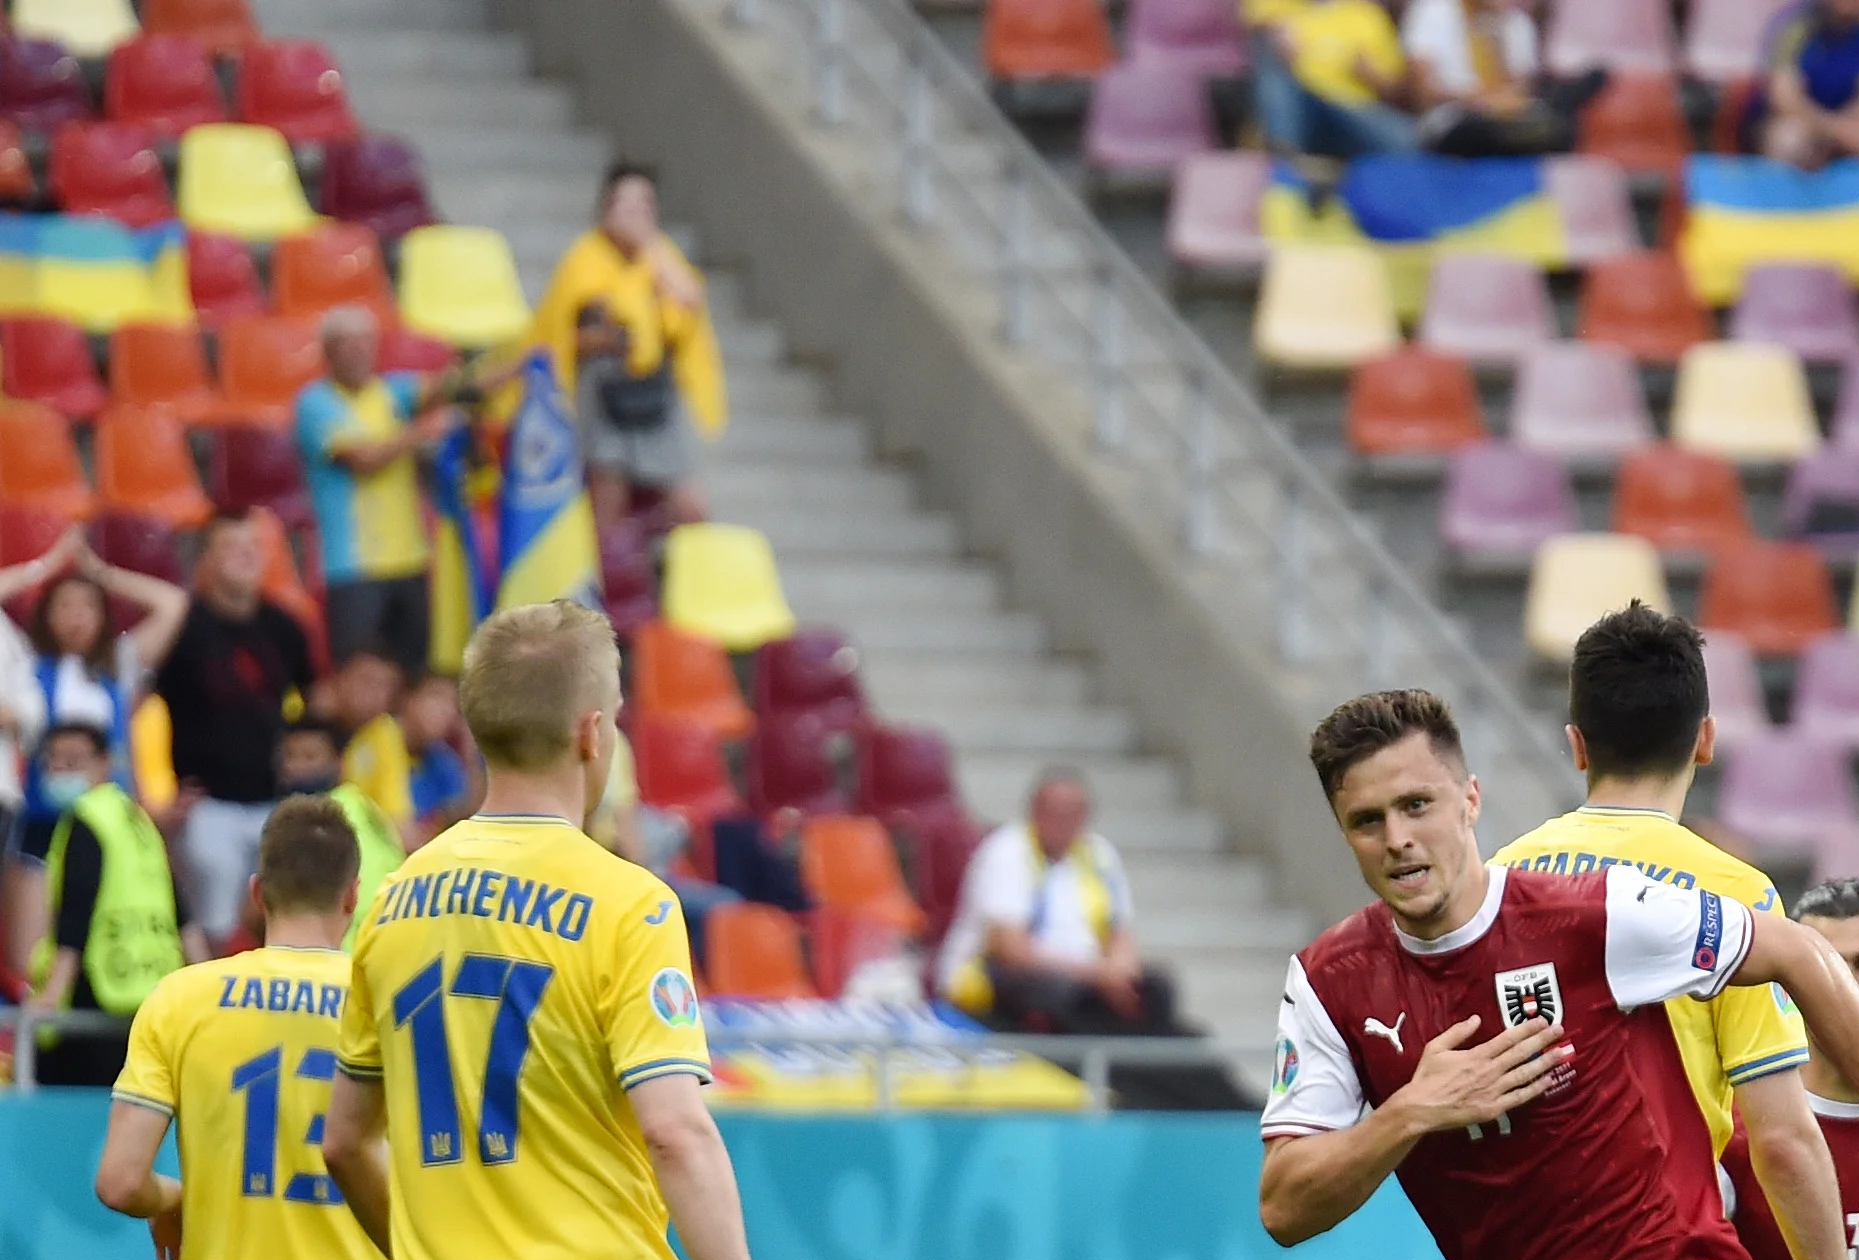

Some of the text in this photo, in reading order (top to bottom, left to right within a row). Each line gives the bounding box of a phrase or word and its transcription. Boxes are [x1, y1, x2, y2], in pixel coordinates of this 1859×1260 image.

[376, 868, 594, 942] ZINCHENKO
[217, 975, 349, 1018] ZABAR
[391, 950, 556, 1168] 17
